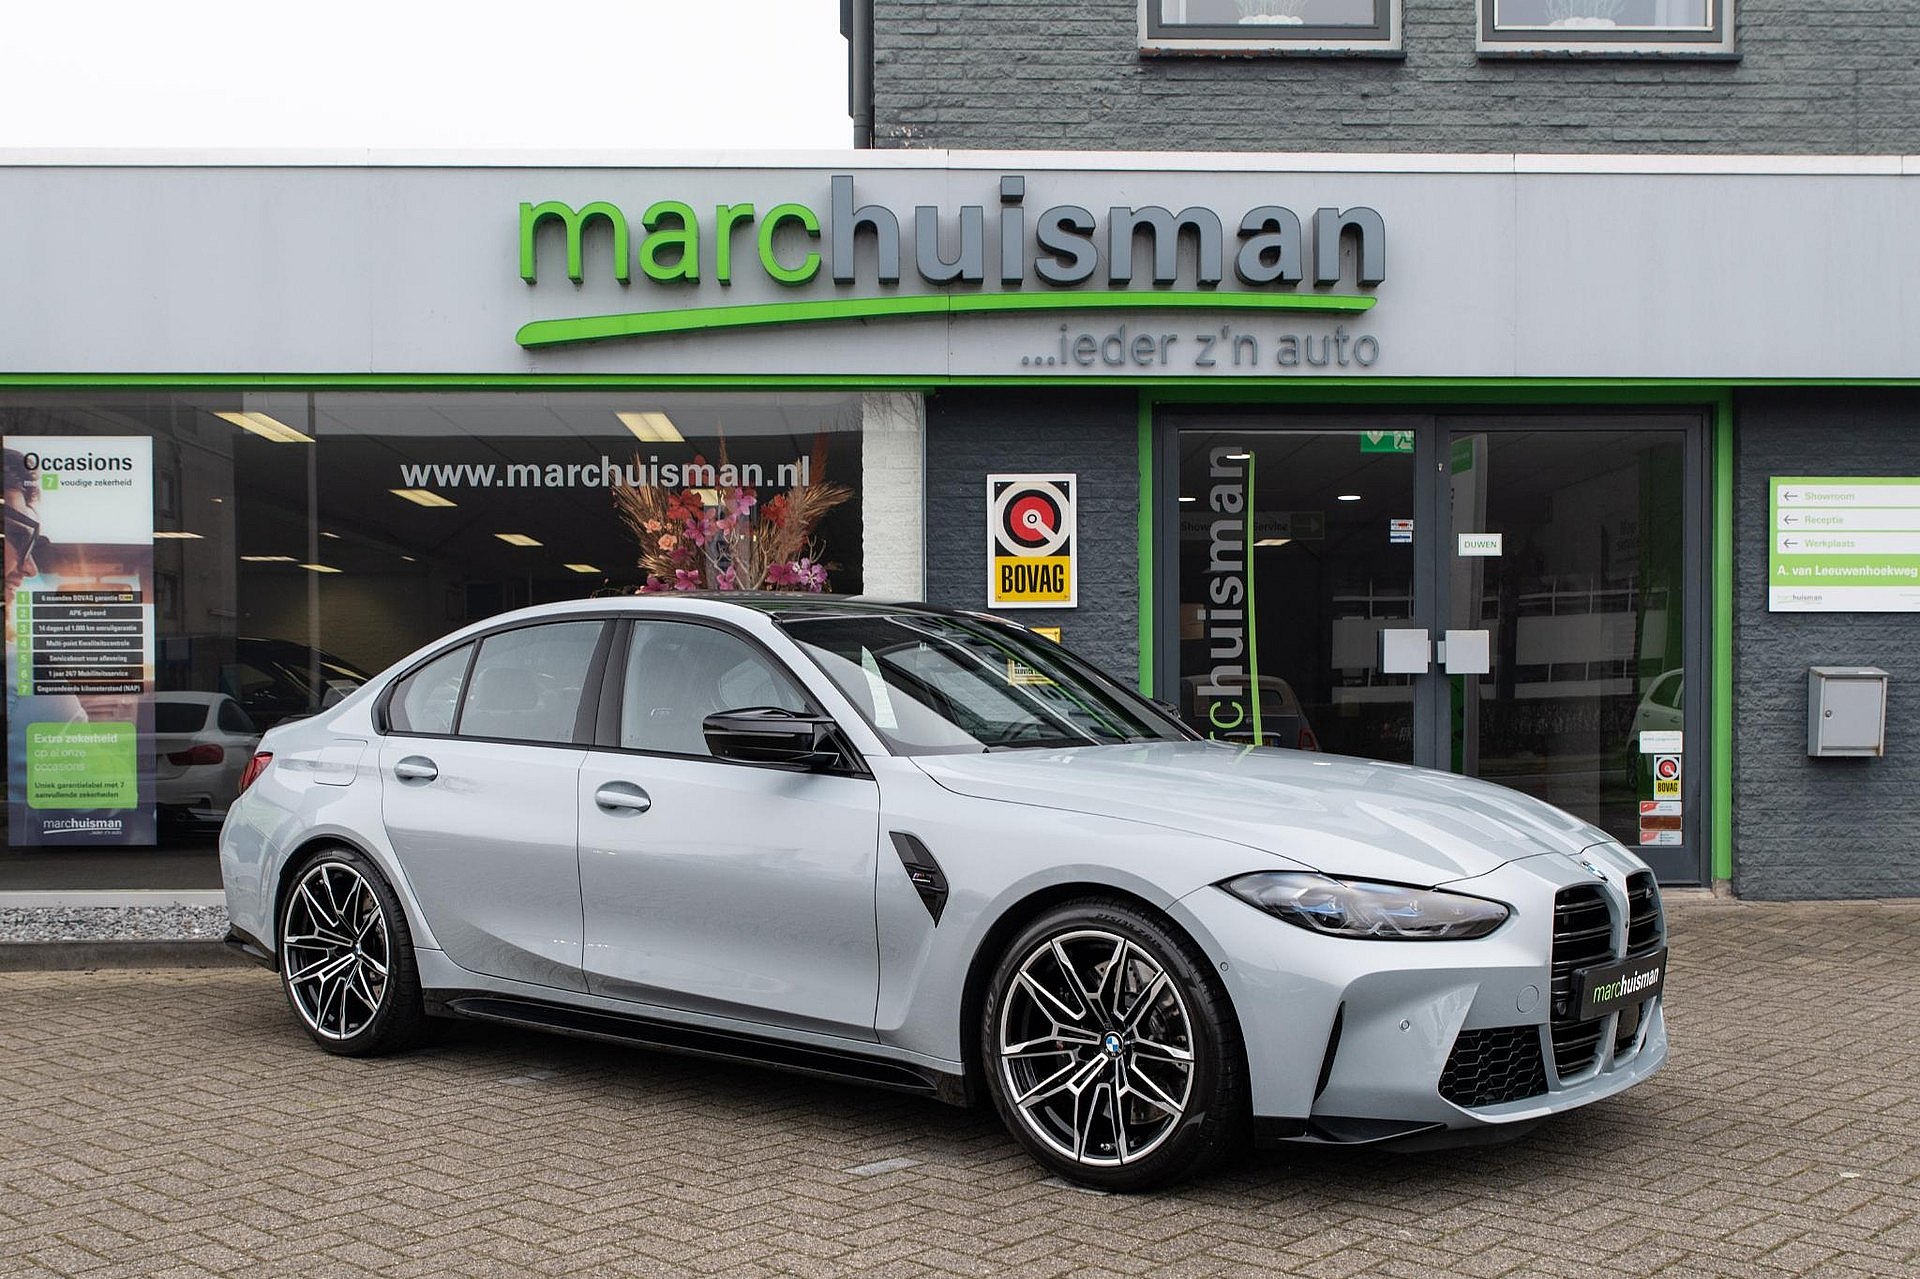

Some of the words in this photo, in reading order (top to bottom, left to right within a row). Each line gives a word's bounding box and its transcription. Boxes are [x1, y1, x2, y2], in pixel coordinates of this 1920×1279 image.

[519, 176, 1385, 286] marchuisman
[1196, 325, 1258, 367] z'n
[1277, 325, 1380, 367] auto
[24, 452, 133, 471] Occasions
[400, 456, 810, 488] www.marchuisman.nl
[60, 480, 92, 488] voudige
[94, 479, 132, 487] zekerheid
[1804, 492, 1855, 501] Showroom
[1804, 516, 1844, 526] Receptie
[1804, 539, 1856, 549] Werkplaats
[1777, 565, 1789, 576] A.
[1792, 567, 1812, 576] van
[1815, 565, 1918, 577] Leeuwenhoekweg
[1001, 564, 1065, 594] BOVAG
[34, 734, 62, 743] Extra
[65, 734, 118, 743] zekerheid
[34, 763, 86, 771] occasions
[1657, 782, 1678, 793] BOVAG
[35, 791, 77, 799] aanvullende
[79, 791, 119, 799] zekerheden
[43, 818, 122, 829] marchuisman
[1593, 967, 1659, 1004] marchuisman
